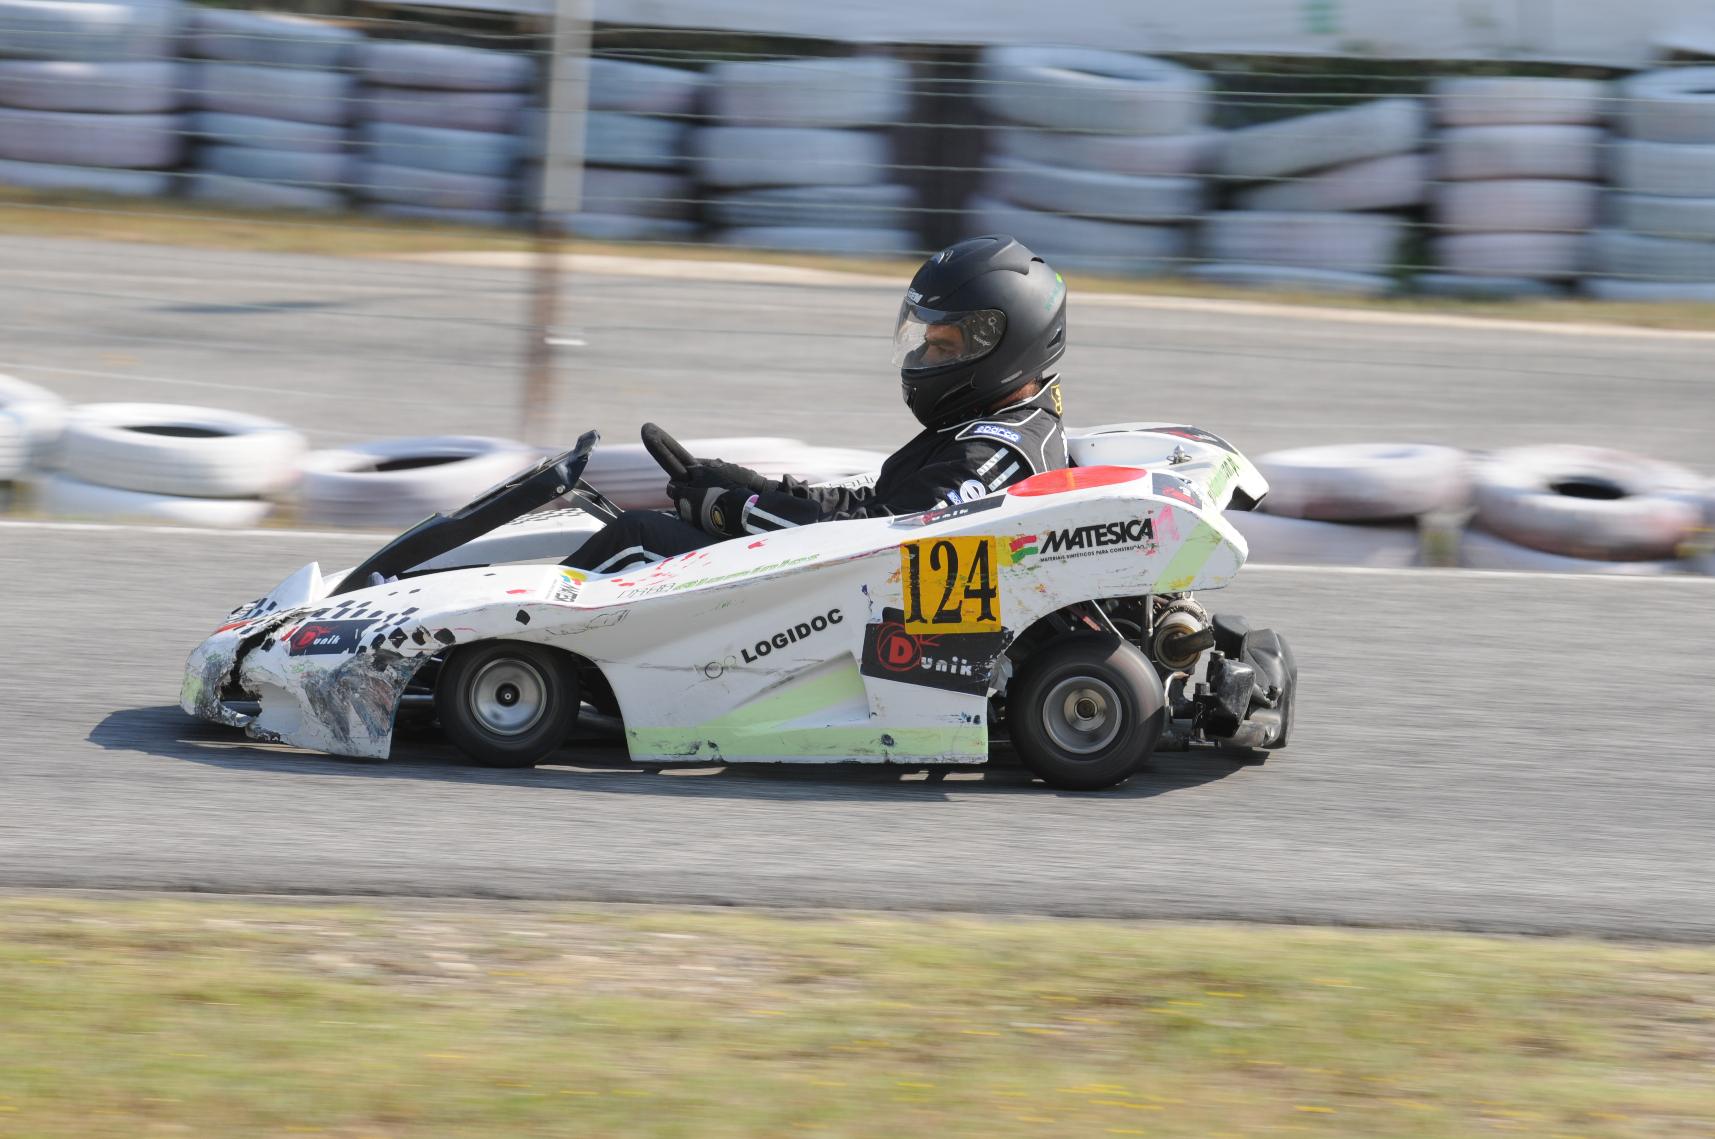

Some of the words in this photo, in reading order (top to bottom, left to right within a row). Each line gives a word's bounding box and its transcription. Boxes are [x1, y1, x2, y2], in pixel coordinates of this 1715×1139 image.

[974, 425, 1020, 442] sparco
[1040, 518, 1154, 554] MATESICA
[904, 540, 997, 624] 124
[741, 609, 844, 664] LOGIDOC
